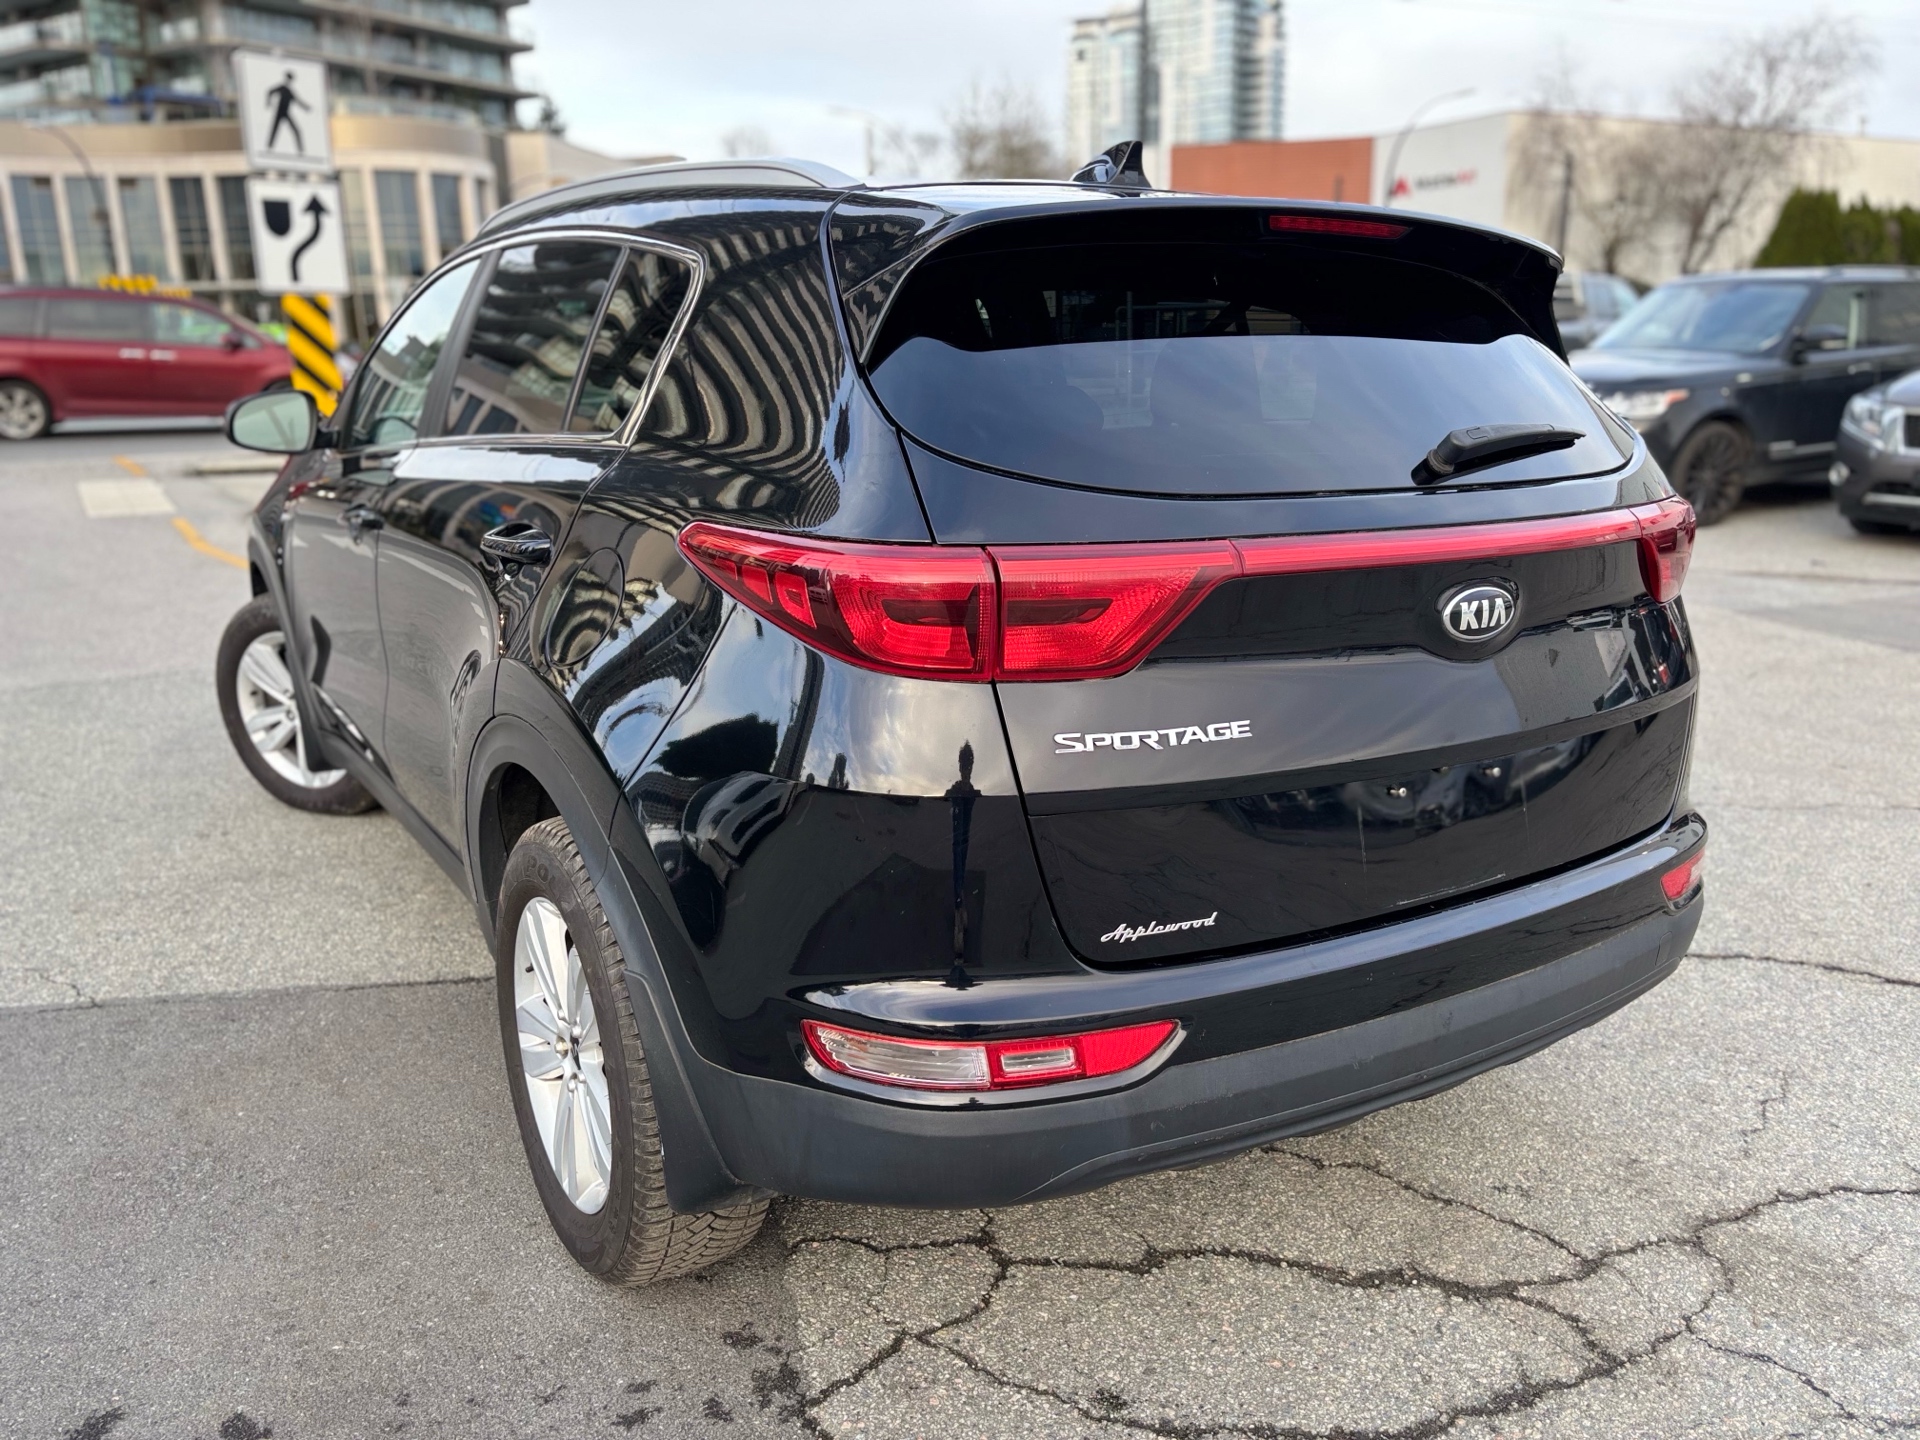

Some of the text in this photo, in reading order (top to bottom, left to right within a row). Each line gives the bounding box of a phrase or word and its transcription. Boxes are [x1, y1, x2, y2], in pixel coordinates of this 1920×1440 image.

[1460, 598, 1506, 630] KIA
[1054, 720, 1252, 754] SPORTAGE
[1101, 912, 1218, 943] Applewood
